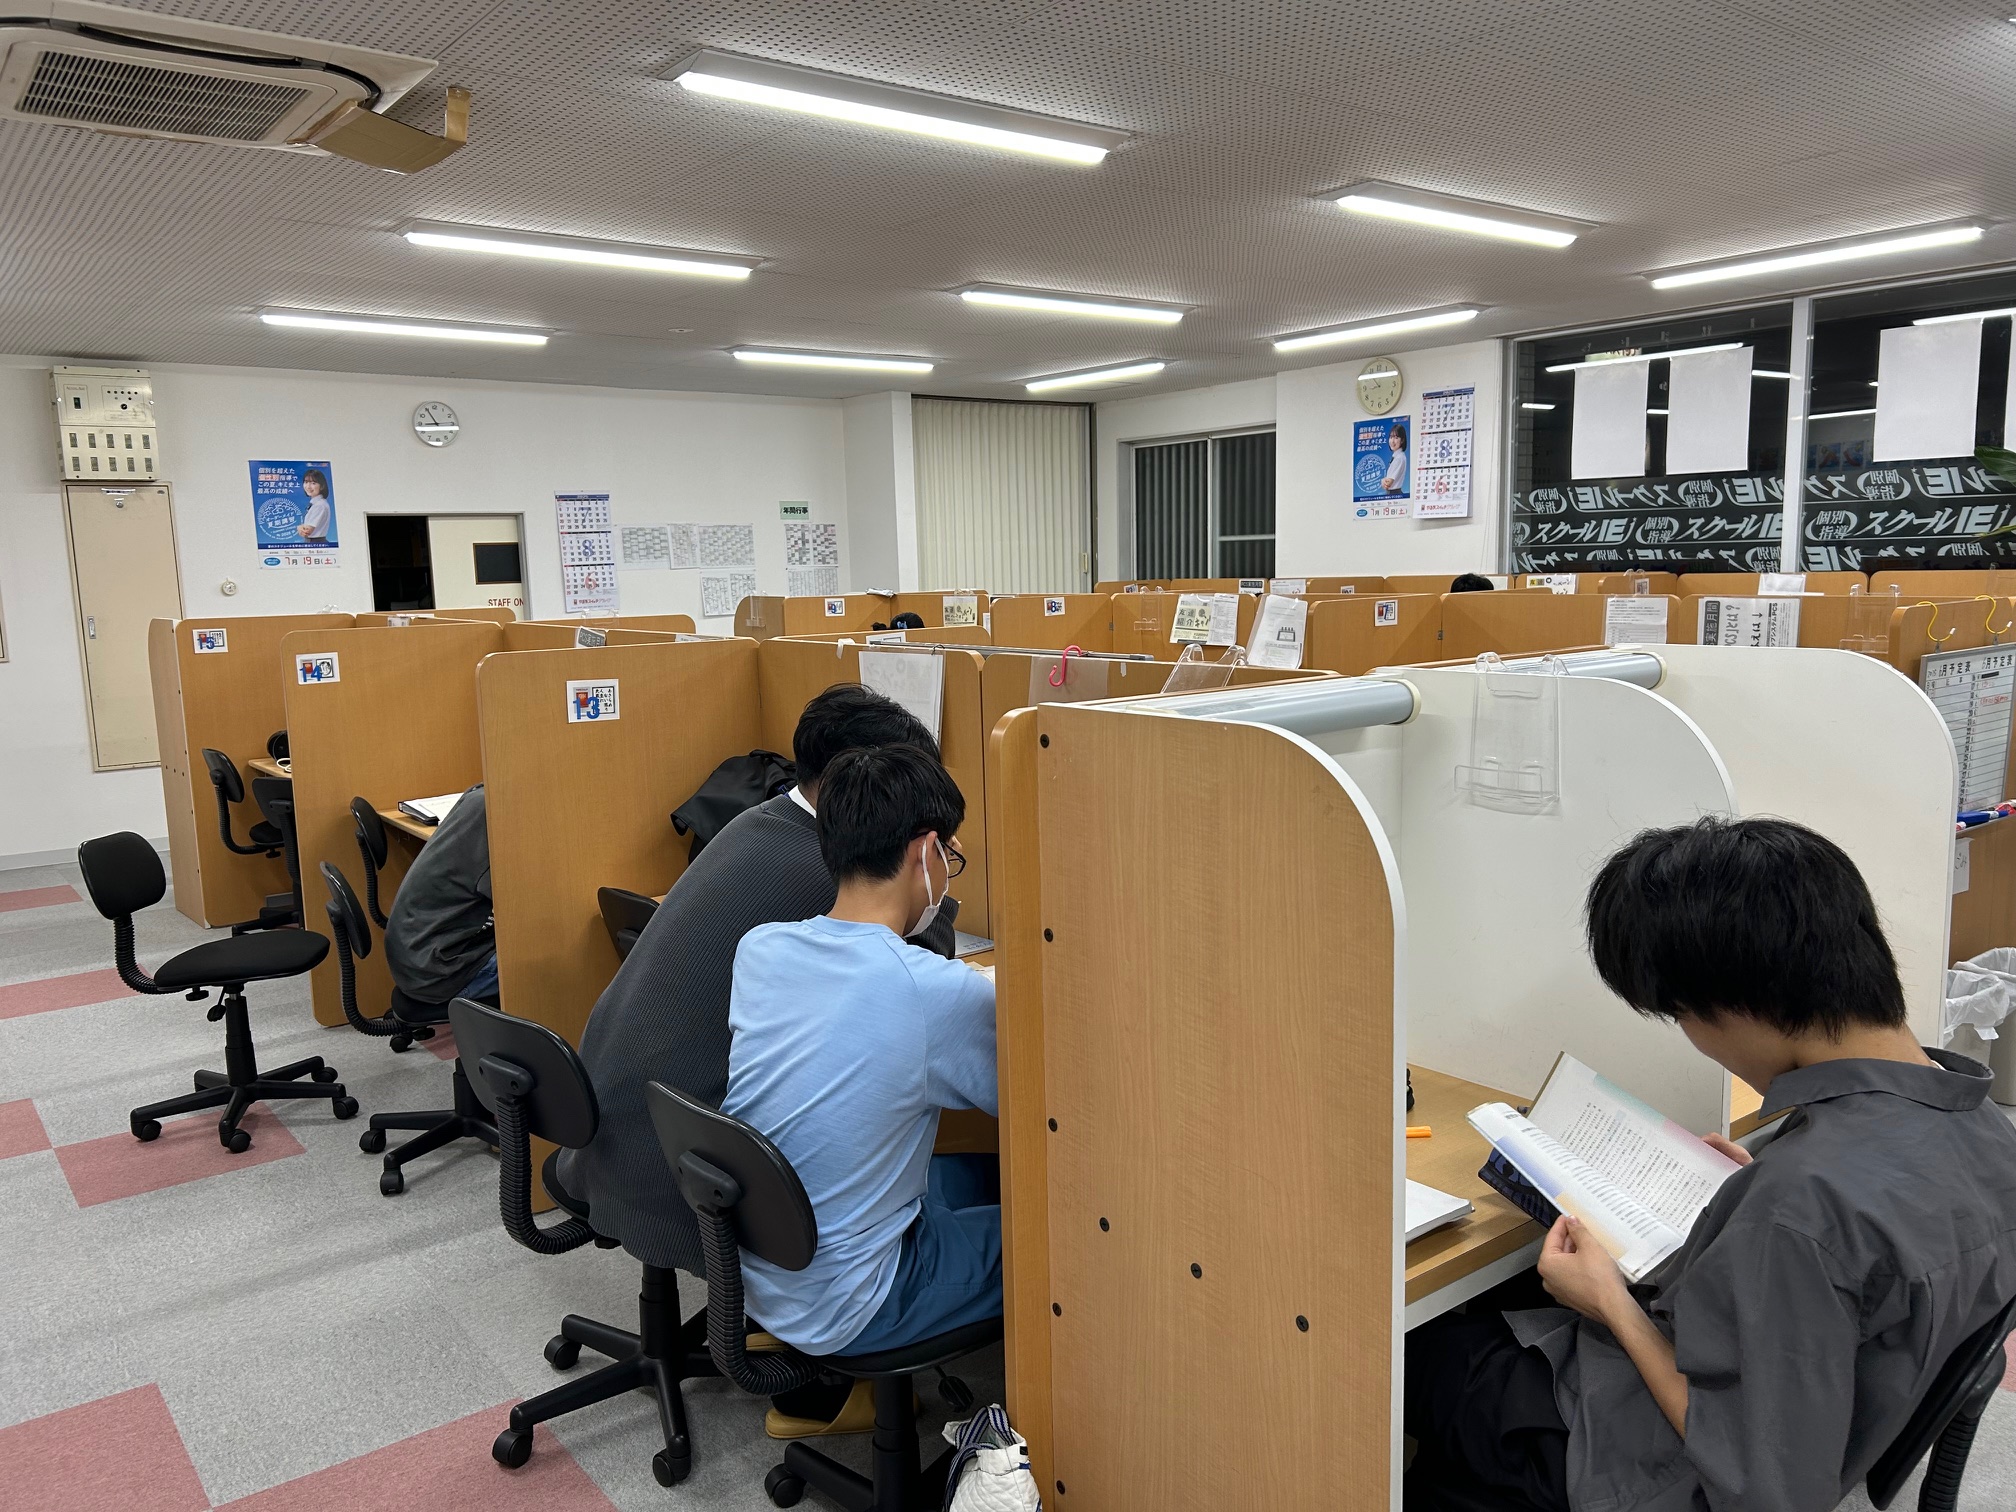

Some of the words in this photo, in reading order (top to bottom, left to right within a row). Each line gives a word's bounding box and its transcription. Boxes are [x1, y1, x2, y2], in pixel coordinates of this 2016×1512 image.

[1646, 517, 1669, 530] 個別
[1816, 510, 1846, 525] 個別
[1854, 504, 2000, 536] スクールIE
[1528, 518, 1624, 544] スクールIE
[1704, 602, 1718, 646] 実施月間
[198, 637, 215, 650] 15
[300, 665, 322, 682] 14
[573, 696, 600, 719] 13
